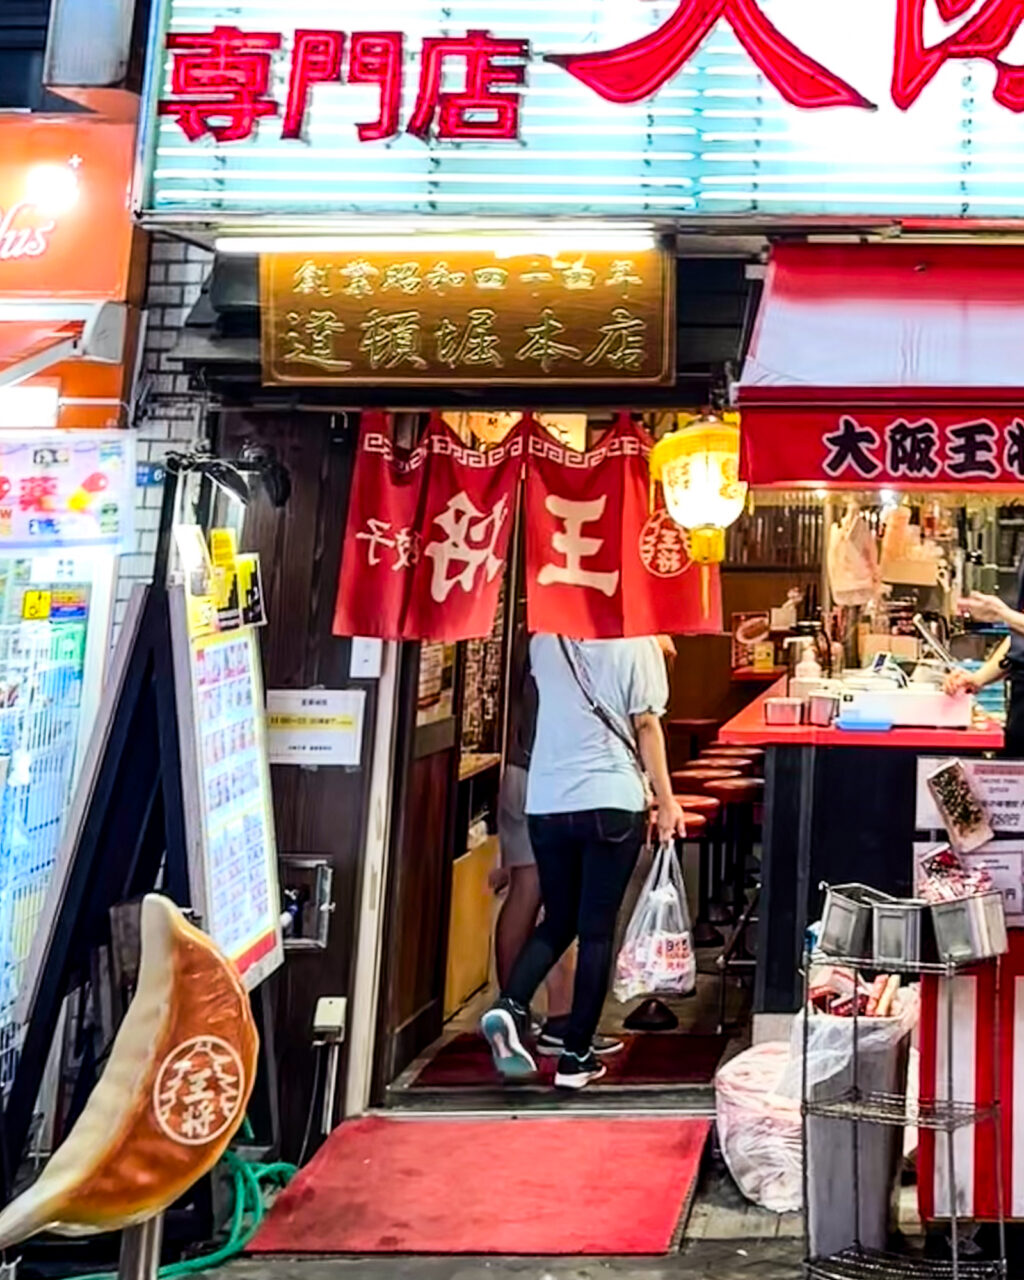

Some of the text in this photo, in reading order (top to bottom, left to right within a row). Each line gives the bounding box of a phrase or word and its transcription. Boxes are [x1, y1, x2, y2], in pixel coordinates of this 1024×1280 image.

[158, 25, 530, 142] 専門店
[284, 308, 650, 372] 道頓堀本店
